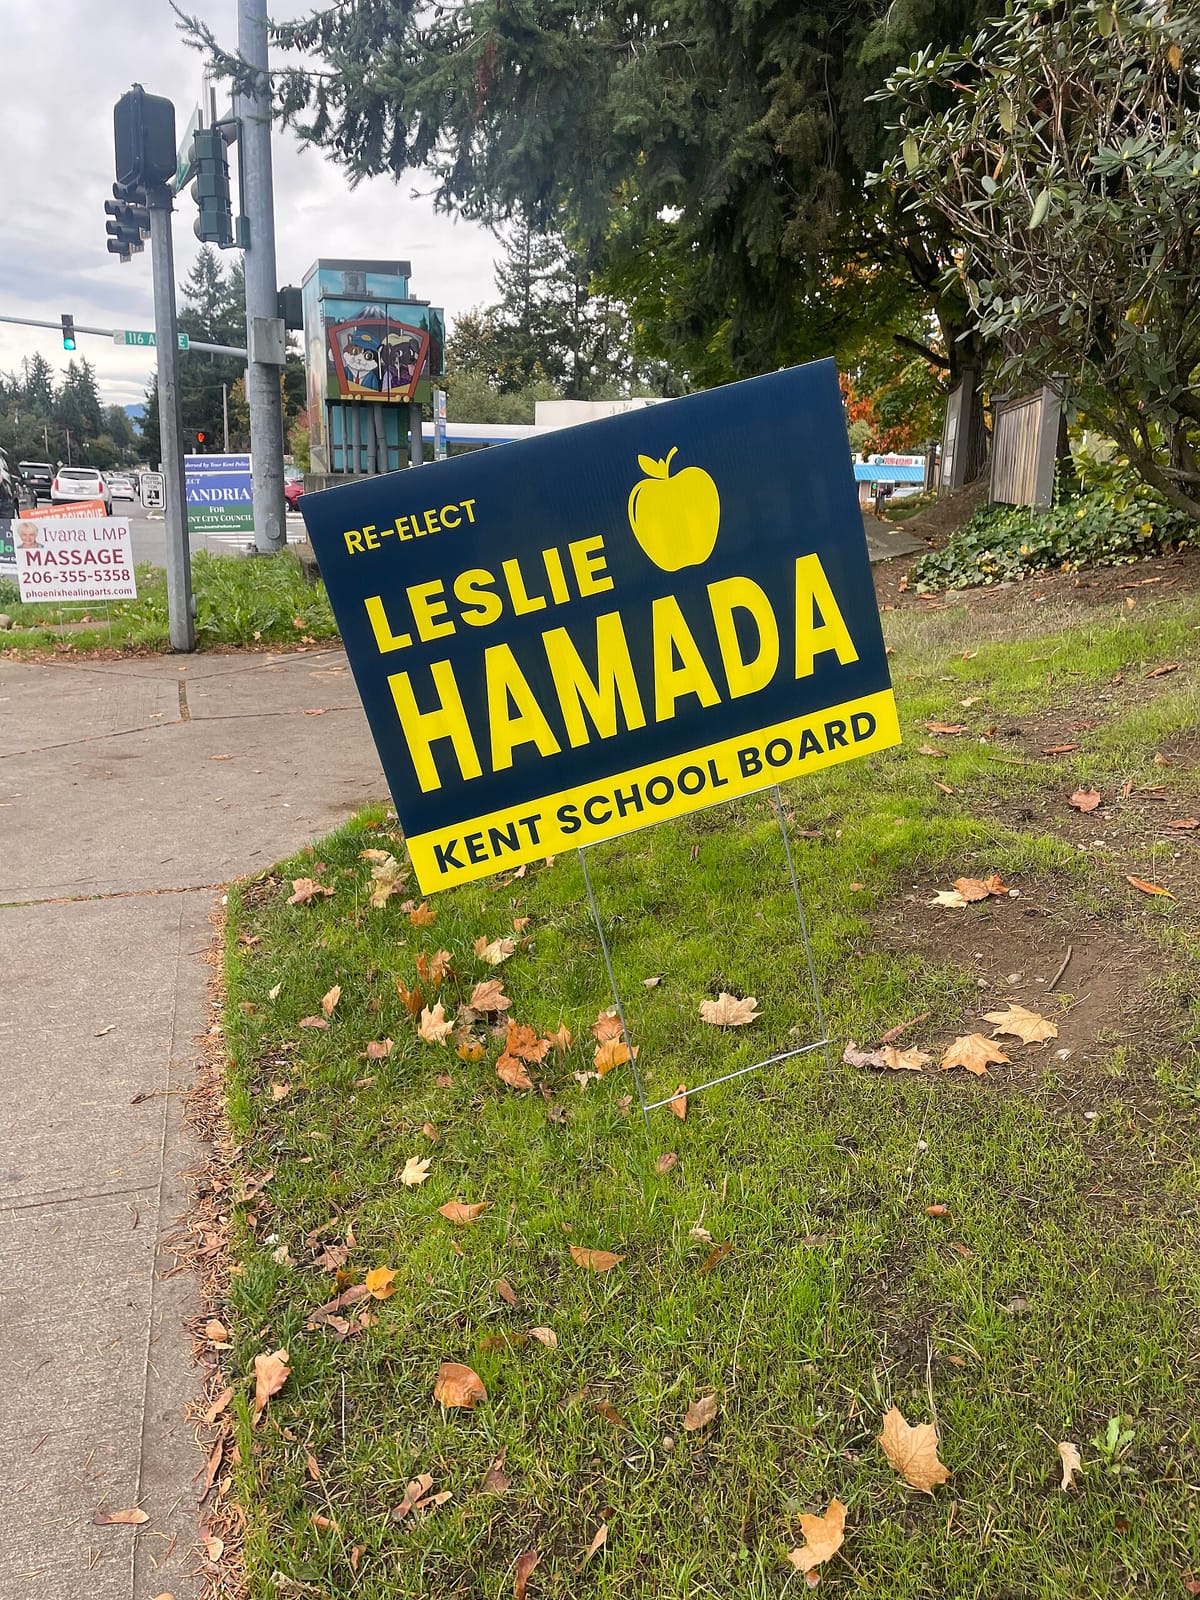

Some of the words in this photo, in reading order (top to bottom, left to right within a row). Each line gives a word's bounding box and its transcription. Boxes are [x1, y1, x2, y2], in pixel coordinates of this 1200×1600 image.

[128, 332, 144, 344] 116
[186, 487, 251, 502] ANDRIA
[43, 527, 87, 542] Ivana
[93, 527, 127, 541] LMP
[343, 499, 478, 556] RE-ELECT
[25, 549, 125, 567] MASSAGE
[22, 569, 131, 584] 206-355-5358
[25, 587, 133, 599] phoenixhealingarts.com
[363, 534, 616, 655] LESLIE
[386, 553, 861, 794] HAMADA
[433, 813, 543, 874] KENT
[556, 758, 729, 835] SCHOOL
[737, 711, 878, 780] BOARD
